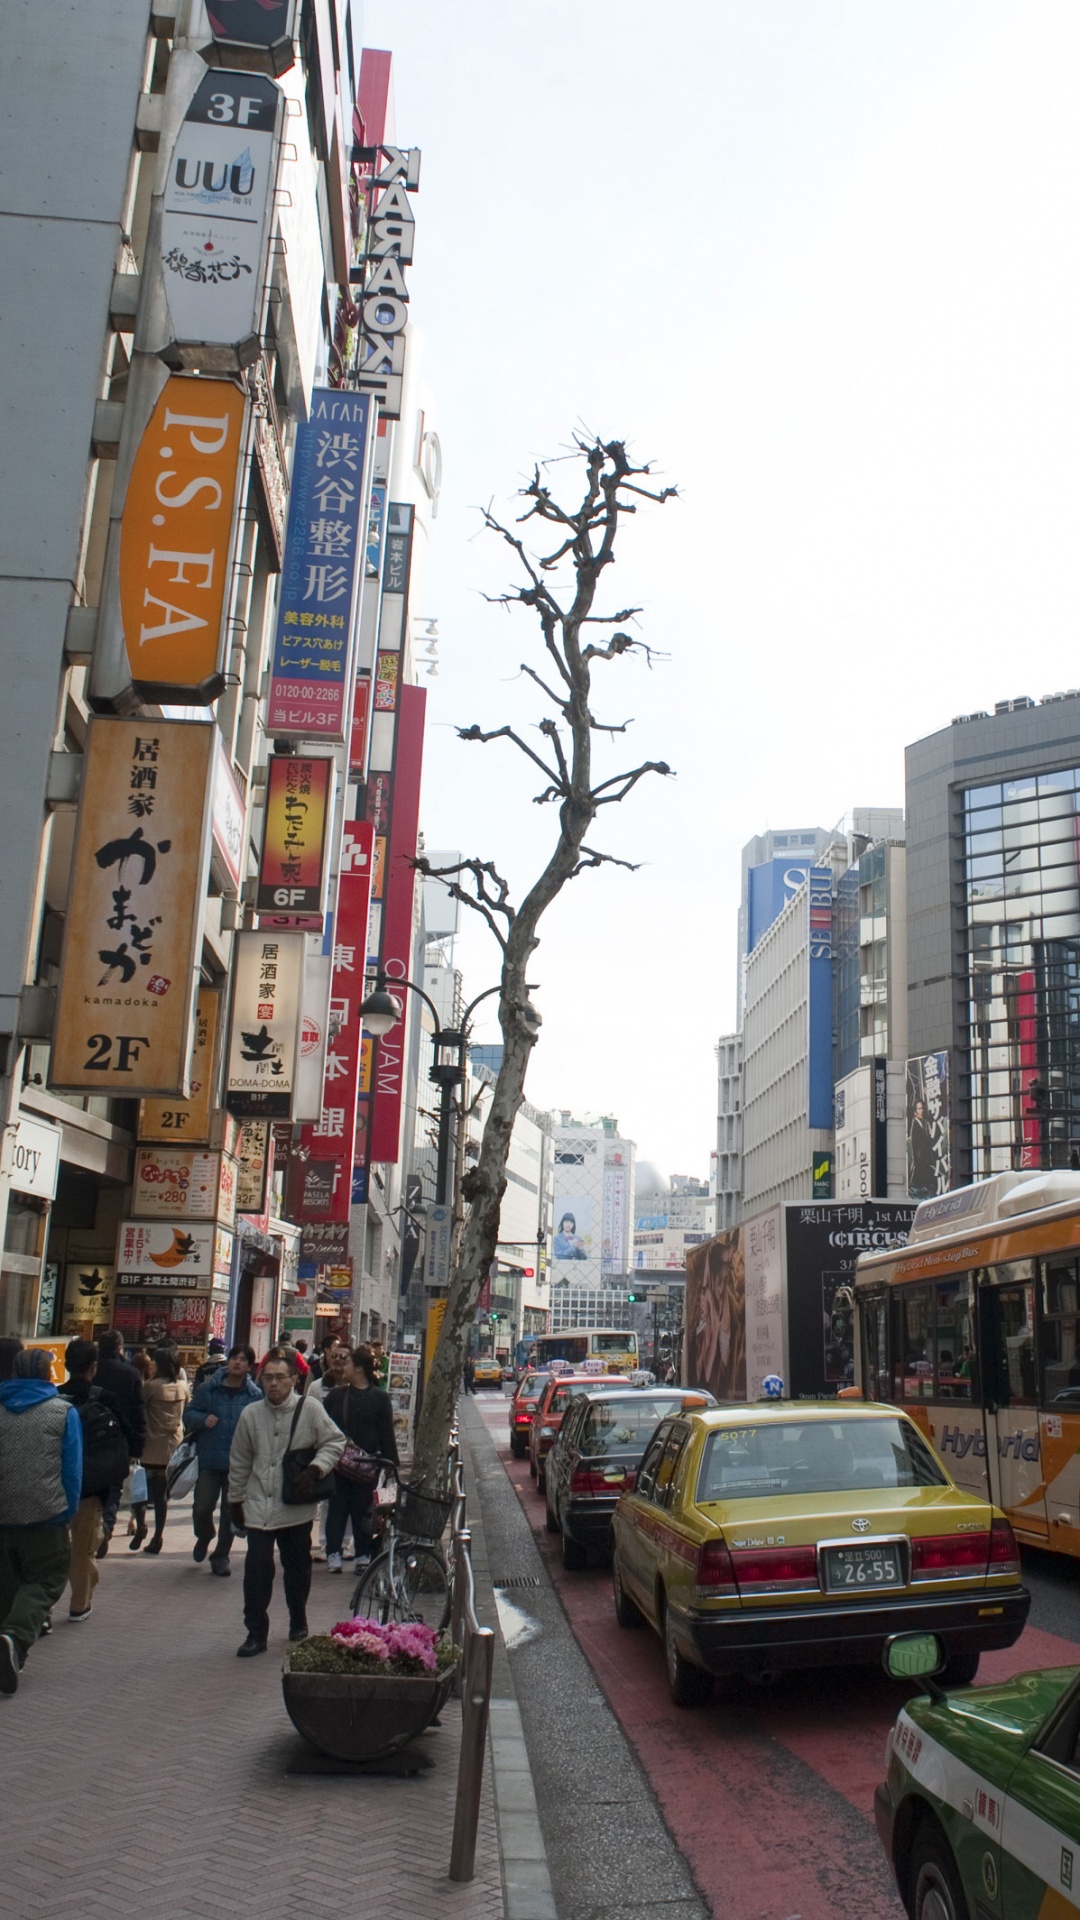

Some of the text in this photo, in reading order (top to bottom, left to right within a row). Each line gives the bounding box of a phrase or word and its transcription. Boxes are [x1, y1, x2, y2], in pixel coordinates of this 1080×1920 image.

[207, 93, 263, 125] 3F
[175, 158, 255, 196] UUU
[303, 430, 359, 603] 渋谷整形
[138, 412, 229, 647] P.S.FA
[387, 539, 404, 589] 岩本ビル
[284, 611, 345, 629] 美容外科
[282, 635, 344, 651] ピアス穴あけ
[280, 657, 342, 672] レーザー脱毛
[275, 684, 340, 701] 0120-00-2266
[273, 709, 339, 726] 当ビル3F
[127, 737, 160, 817] 居酒家
[299, 762, 312, 795] 炭火焼
[95, 826, 172, 987] かまどか
[273, 888, 306, 906] 6F
[810, 875, 833, 959] SEIBU
[258, 943, 279, 1000] 居酒家
[84, 995, 159, 1008] kamadoka
[258, 1004, 274, 1020] 宴
[83, 1033, 151, 1072] 2F
[230, 1077, 291, 1089] DOMA-DOMA
[250, 1093, 268, 1102] B1F
[161, 1111, 190, 1129] 2F
[924, 1056, 951, 1196] 金融サバイバル
[303, 1191, 329, 1199] PASELA
[800, 1207, 864, 1224] 栗山千明
[876, 1210, 891, 1222] 1st
[923, 1196, 963, 1220] Hybrid
[302, 1222, 349, 1241] カラオケ
[303, 1243, 345, 1255] Dining
[439, 1224, 448, 1261] SECURITY
[896, 1247, 979, 1273] Hybrid Non-step Bus
[120, 1275, 198, 1287] B1F 土間土間渋谷
[720, 1430, 757, 1441] 5077
[941, 1425, 1041, 1462] Hybrid
[864, 1550, 882, 1561] 500
[844, 1560, 895, 1583] 26-55
